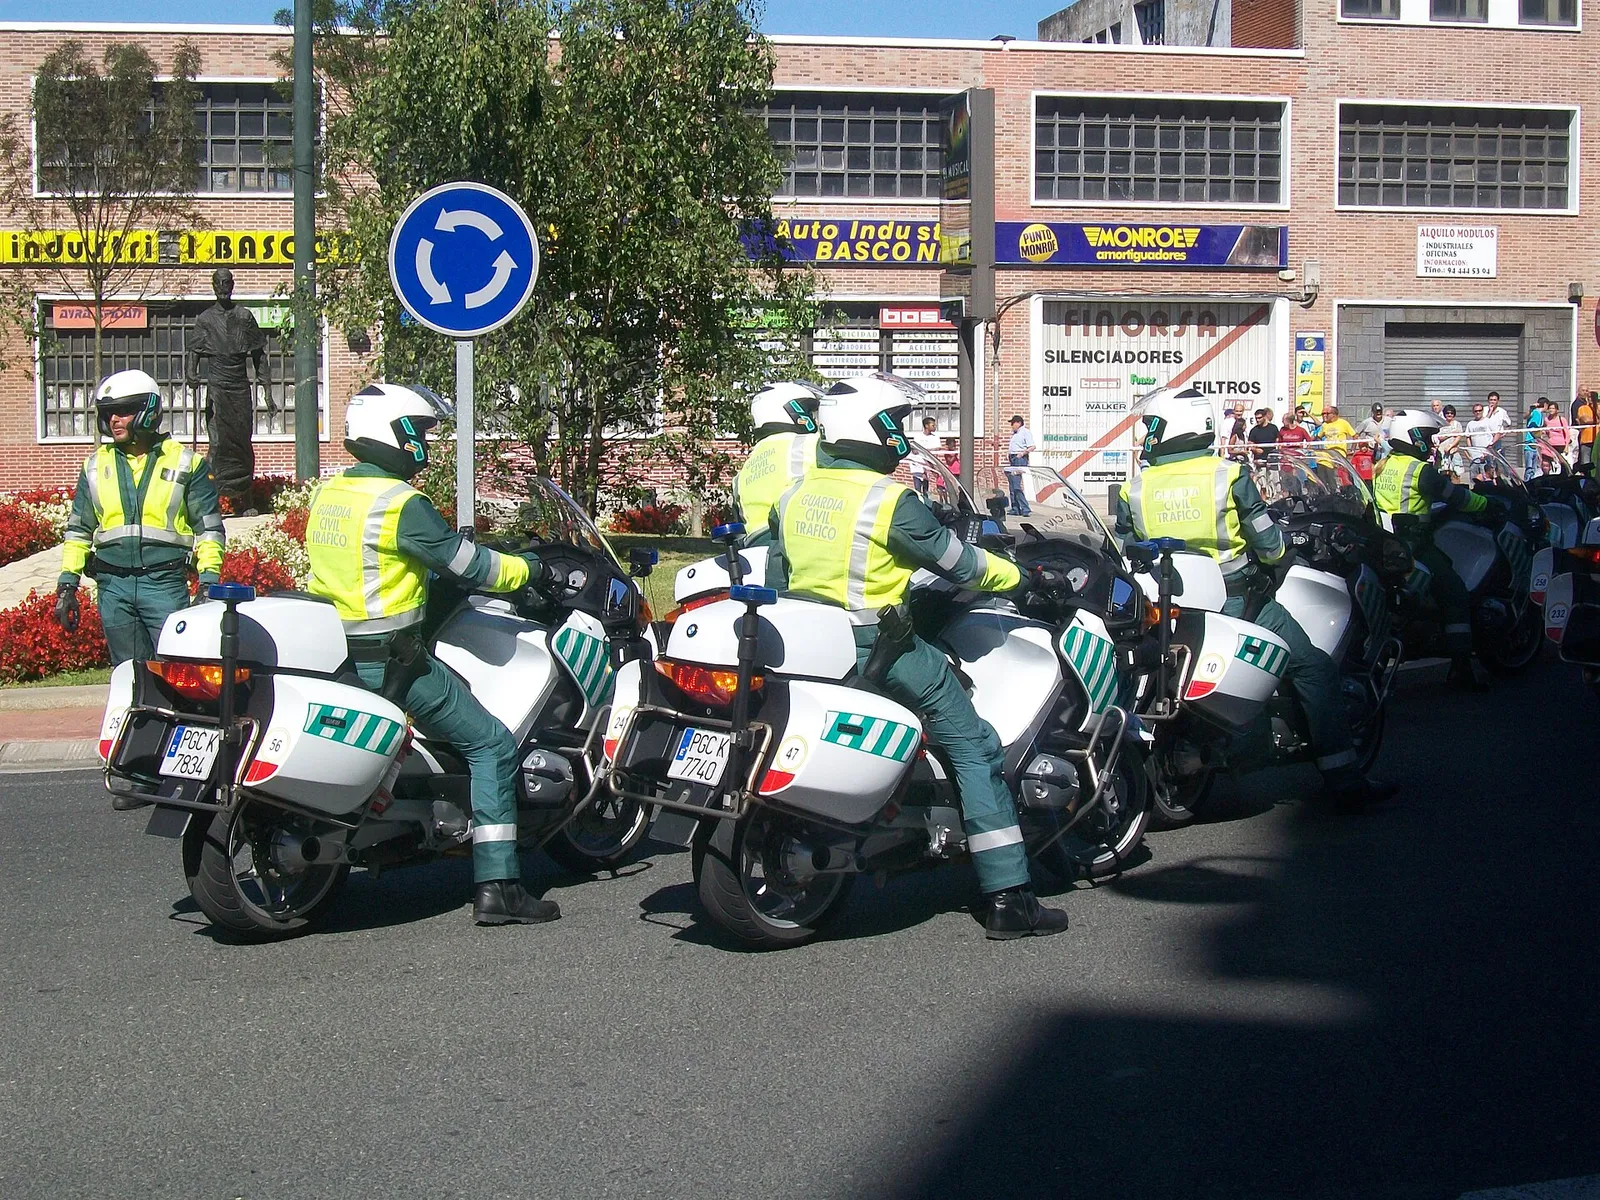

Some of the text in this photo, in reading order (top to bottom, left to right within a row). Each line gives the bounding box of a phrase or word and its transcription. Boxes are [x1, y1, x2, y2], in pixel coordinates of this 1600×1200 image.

[774, 219, 839, 240] Auto
[1023, 229, 1052, 244] PUNTO
[1097, 226, 1186, 248] MONROE
[1420, 228, 1495, 239] ALQUILO MODULOS
[11, 234, 194, 259] industril
[1021, 239, 1057, 257] MONROE
[1426, 242, 1473, 250] INDUSTRIALES
[1096, 248, 1187, 263] amortiguadores
[882, 308, 941, 323] bos
[1064, 310, 1218, 338] FINORSA
[1044, 350, 1184, 364] SILENCIADORES
[1192, 381, 1261, 395] FILTROS
[745, 447, 776, 469] GUARDIA
[750, 458, 770, 474] CIVIL
[745, 463, 776, 486] TRAFICO
[1375, 483, 1397, 492] RAFICO
[316, 503, 352, 519] GUARDIA
[801, 493, 844, 513] GUARDIA
[1163, 500, 1191, 512] CIVIL
[804, 507, 832, 525] CIVIL
[1157, 509, 1201, 524] TRAFICO
[319, 517, 340, 533] CIVIL
[795, 520, 837, 542] TRAFICO
[312, 530, 347, 548] TRAFICO
[1551, 608, 1566, 619] 232
[1206, 661, 1217, 674] 10
[180, 729, 220, 753] PGC K
[269, 738, 282, 752] 56
[689, 732, 730, 759] PGC K
[785, 746, 800, 761] 47
[172, 753, 205, 776] 7834
[680, 756, 718, 781] 7740
